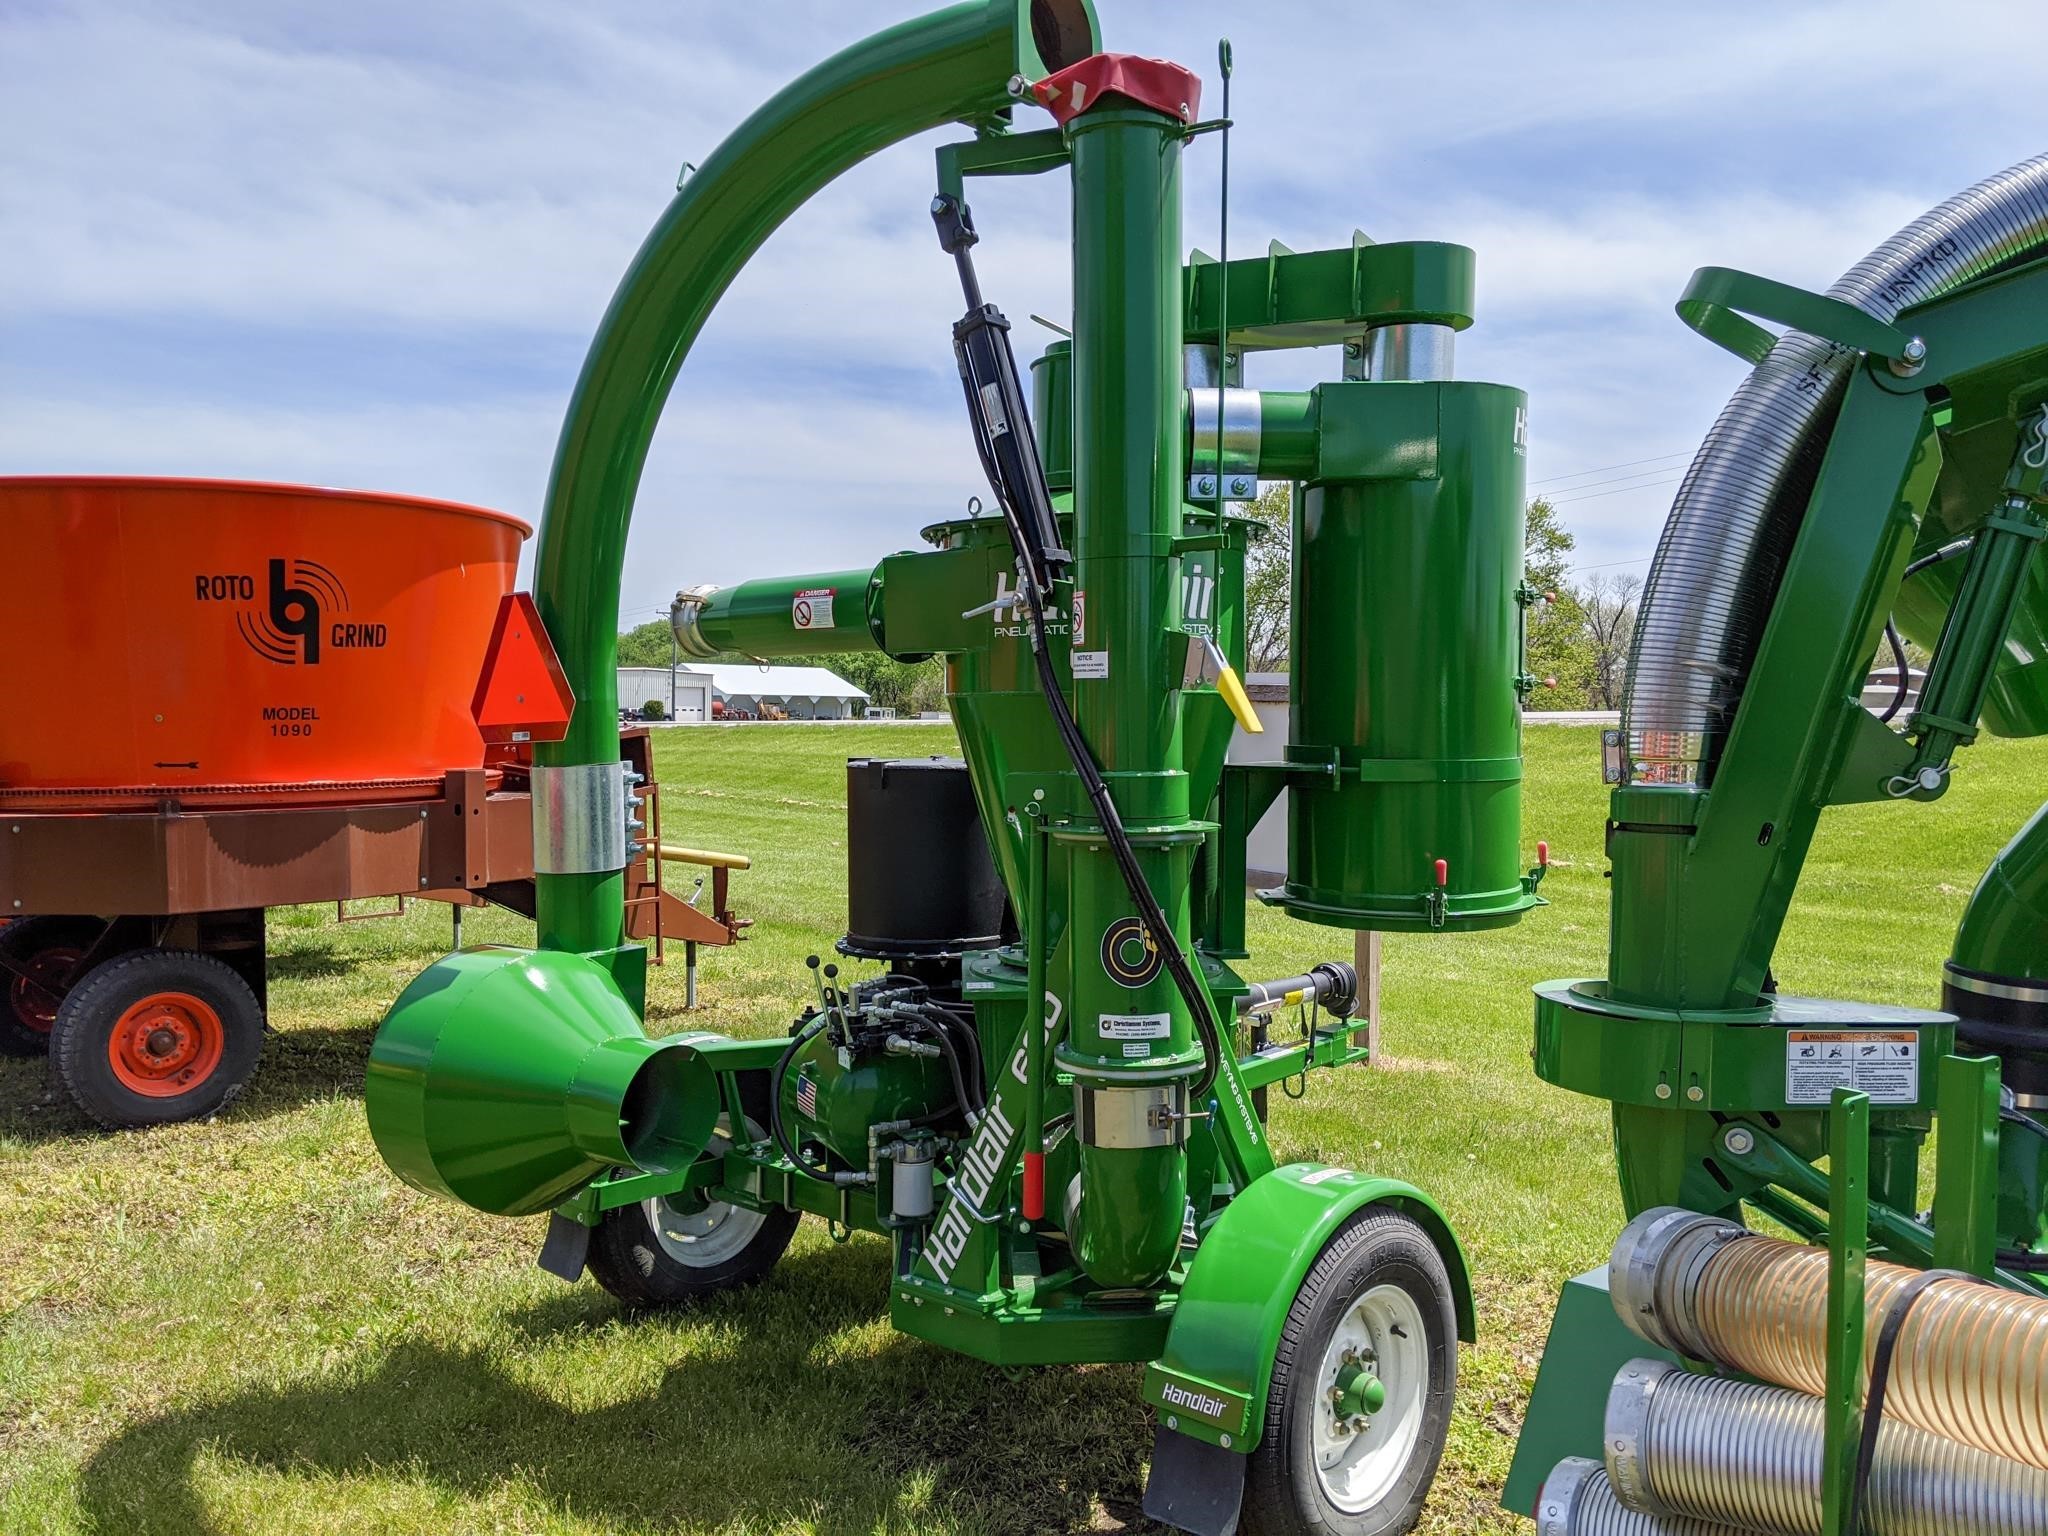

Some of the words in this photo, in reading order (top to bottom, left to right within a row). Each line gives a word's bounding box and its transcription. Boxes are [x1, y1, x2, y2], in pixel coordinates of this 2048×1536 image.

[196, 575, 254, 600] ROTO
[331, 623, 387, 648] GRIND
[994, 624, 1069, 637] PNEUATIC
[262, 707, 320, 720] MODEL
[270, 724, 312, 737] 1090
[923, 1094, 1015, 1284] Handlair
[1162, 1383, 1226, 1417] Handlair
